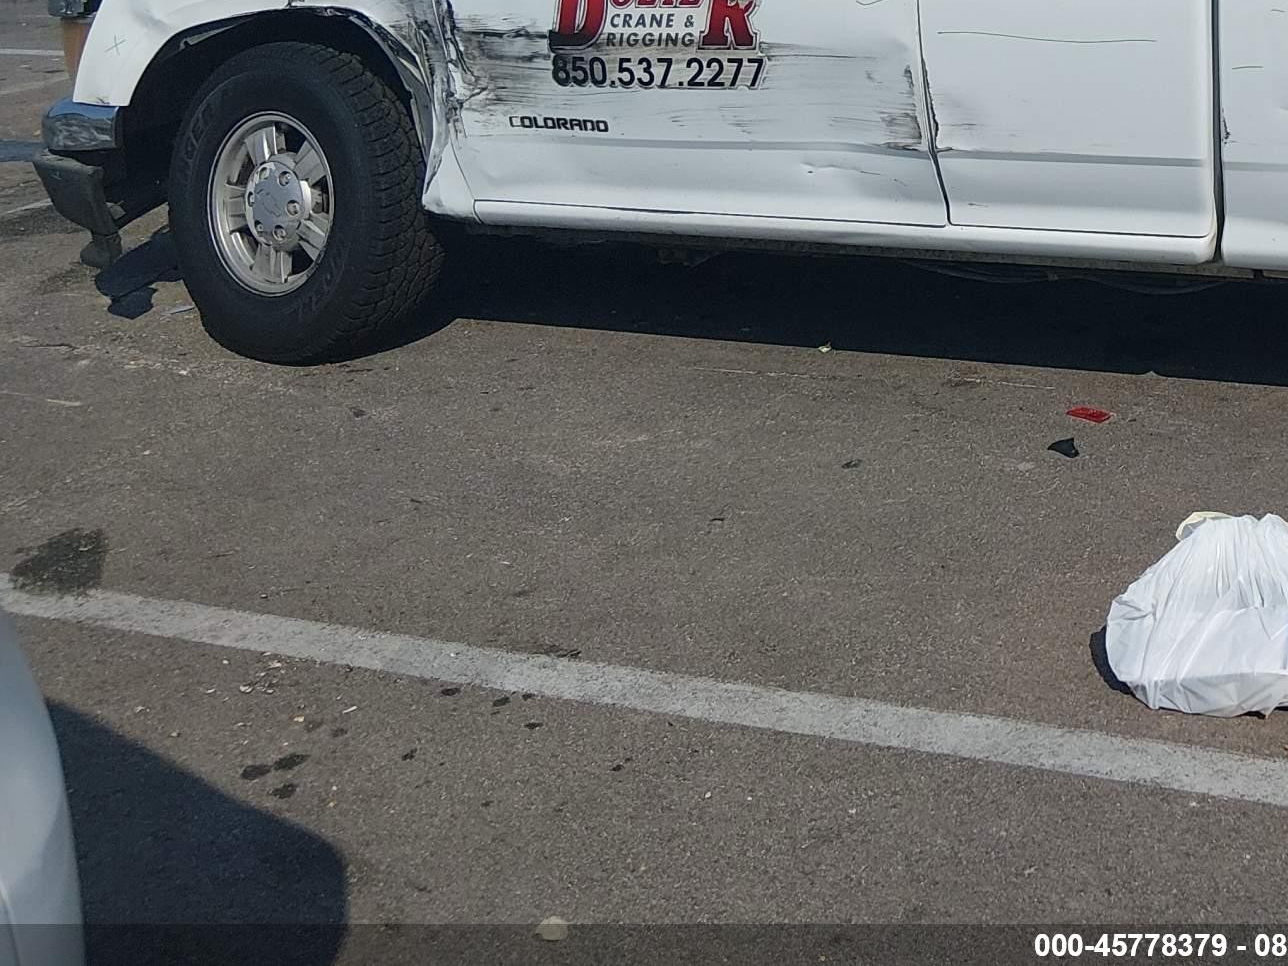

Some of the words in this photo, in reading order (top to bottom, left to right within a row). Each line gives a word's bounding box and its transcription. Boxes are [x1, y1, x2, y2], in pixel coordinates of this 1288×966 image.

[610, 13, 676, 29] CRANE
[684, 14, 695, 28] &
[606, 32, 696, 48] RIGGING
[552, 56, 764, 87] 850.537.2277
[509, 116, 609, 133] COLORADO
